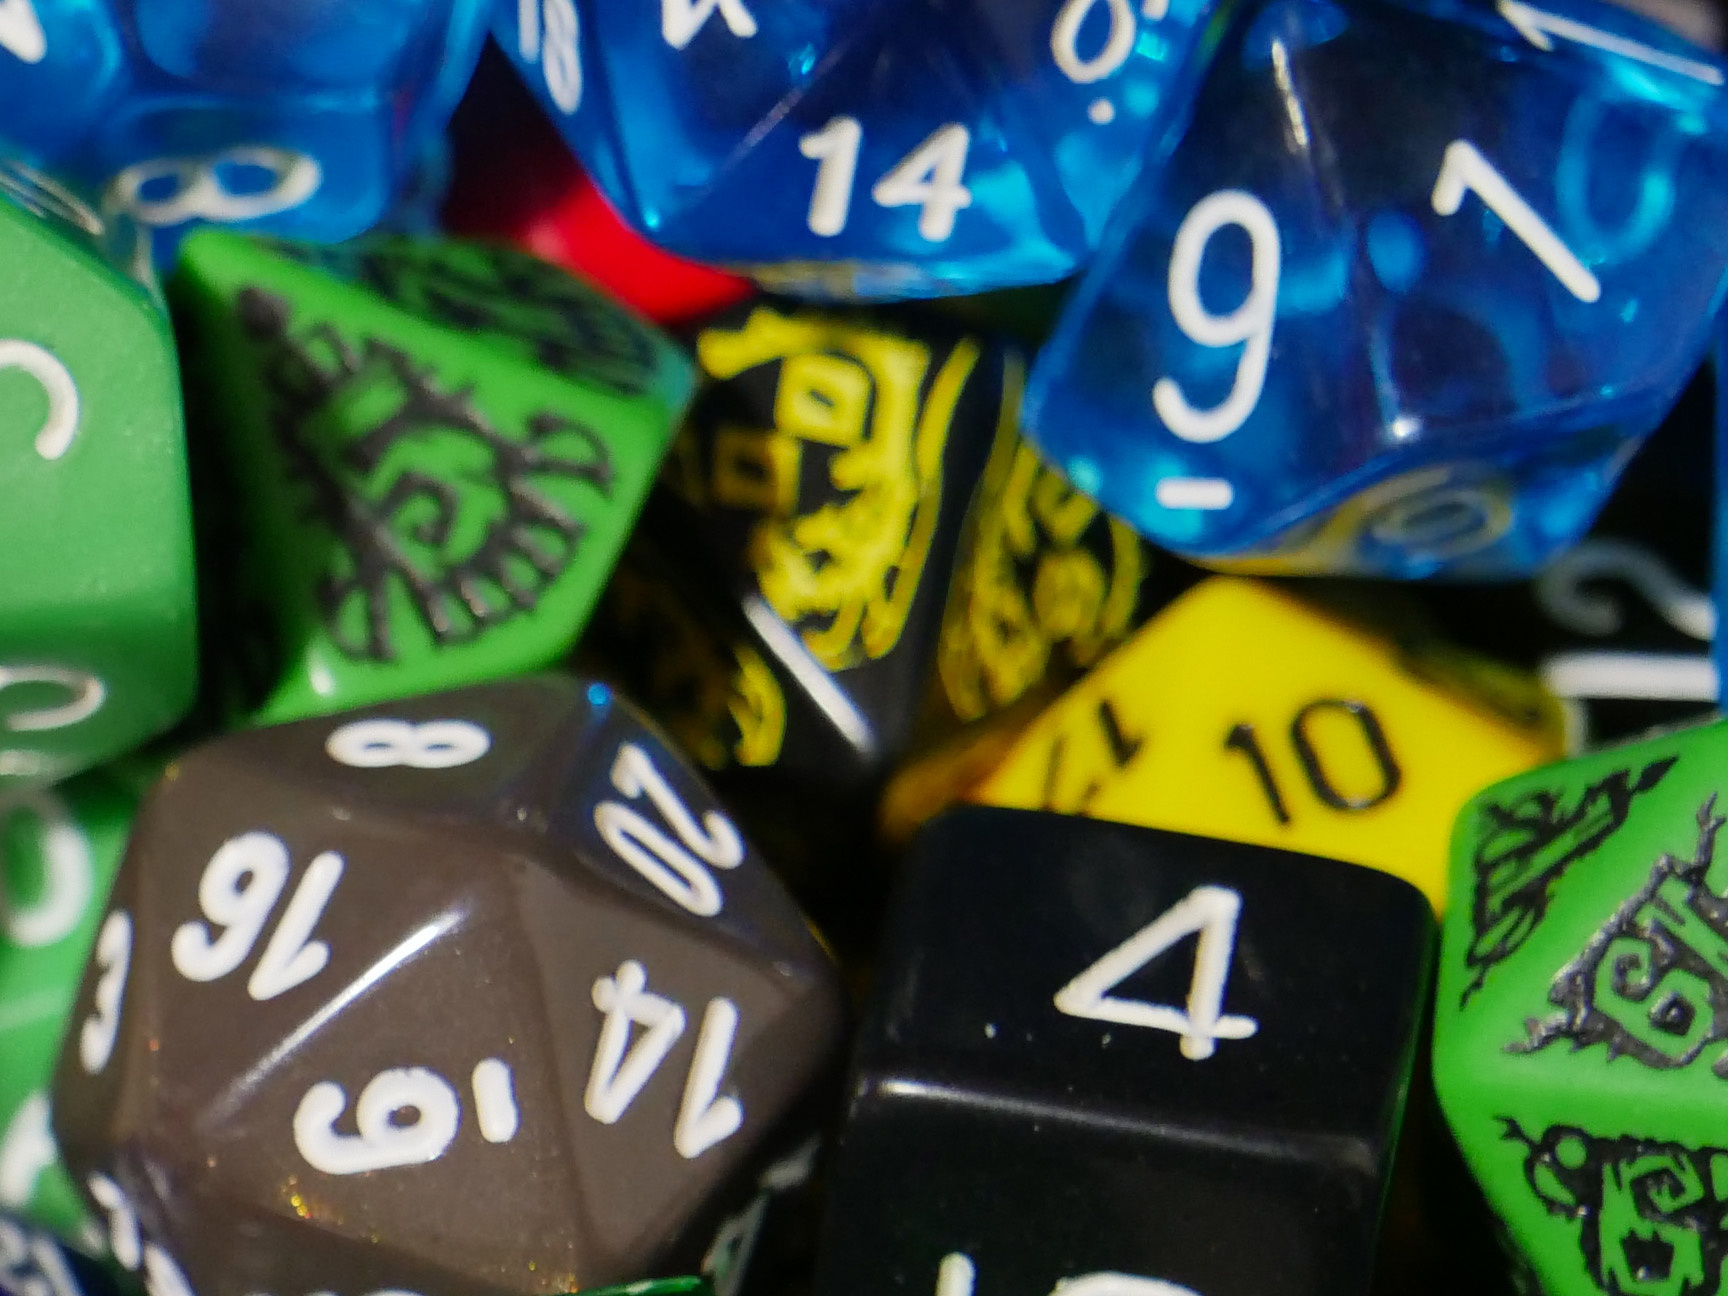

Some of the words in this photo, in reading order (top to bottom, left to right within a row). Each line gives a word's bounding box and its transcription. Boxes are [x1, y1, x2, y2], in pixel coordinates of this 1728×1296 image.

[103, 146, 324, 226] 8
[800, 117, 974, 242] 14
[325, 718, 491, 770] 8
[1224, 698, 1402, 826] 10
[593, 742, 745, 918] 20
[171, 830, 344, 1003] 16
[1054, 884, 1260, 1062] 4
[582, 958, 744, 1160] 14
